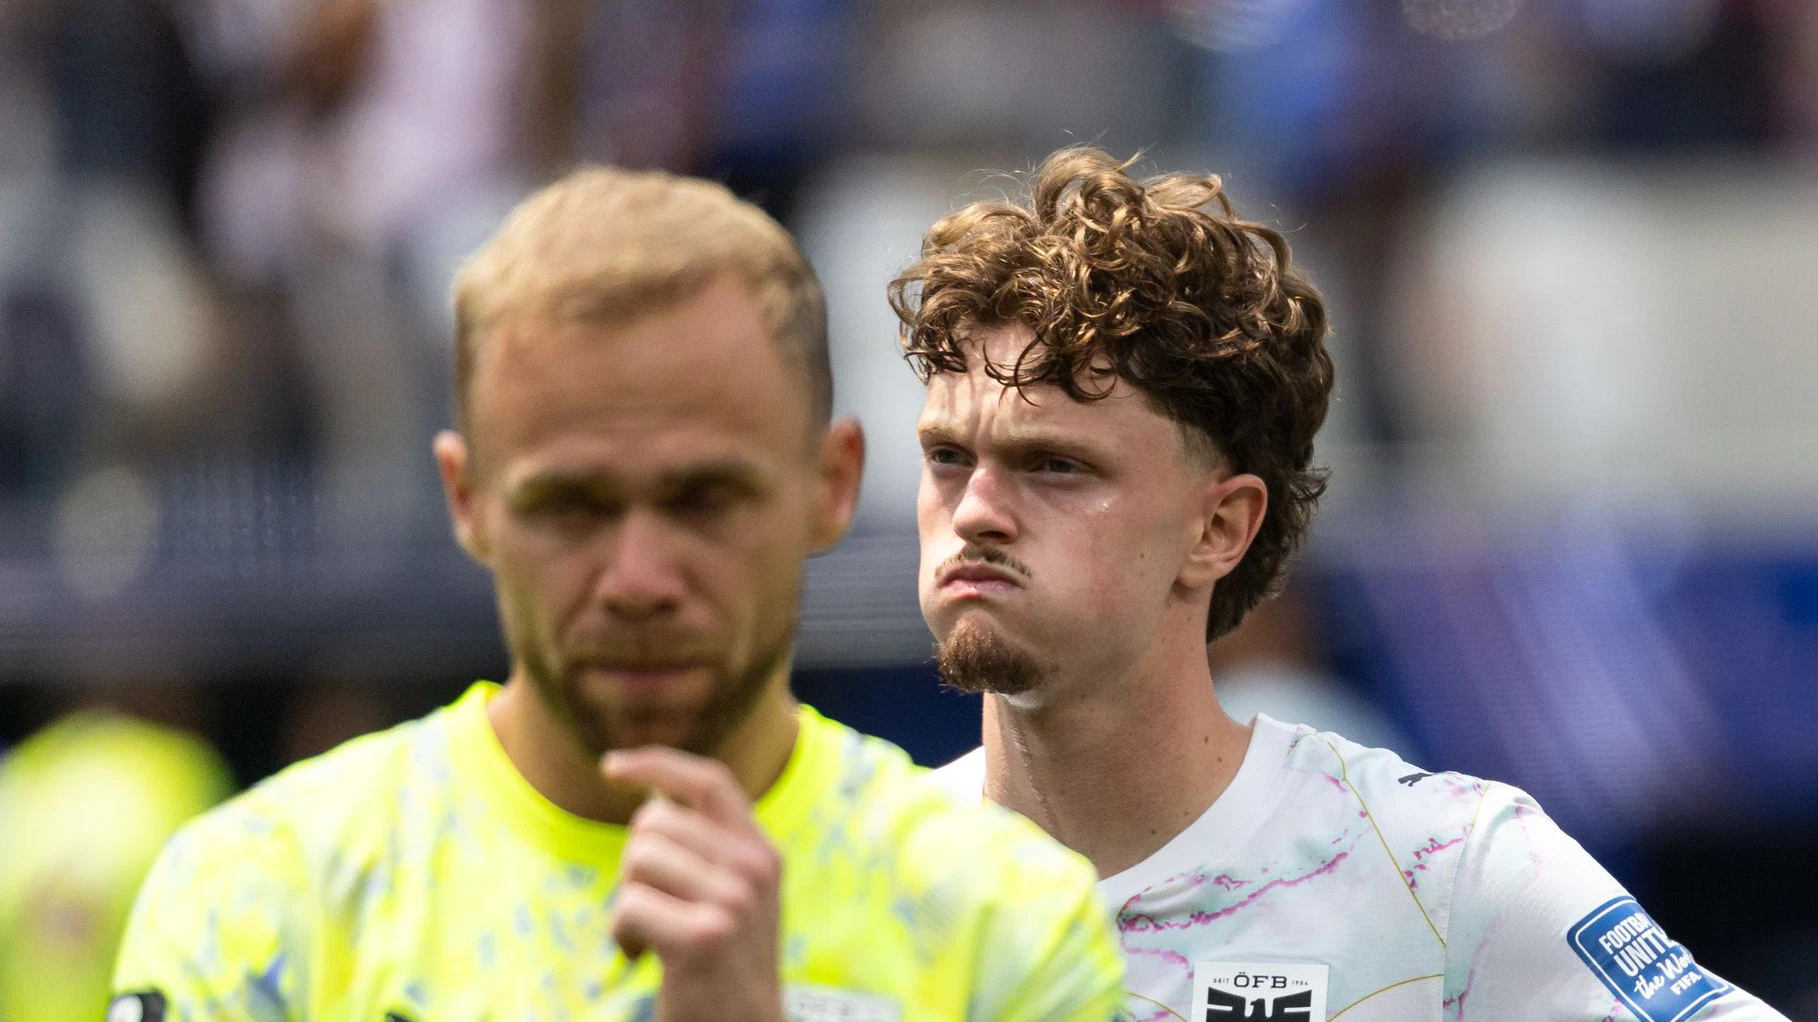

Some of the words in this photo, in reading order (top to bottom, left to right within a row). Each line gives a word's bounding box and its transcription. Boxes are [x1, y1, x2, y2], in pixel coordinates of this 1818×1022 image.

[1598, 912, 1653, 955] FOOTBA
[1613, 926, 1678, 977] UNITE
[1233, 971, 1287, 989] ÖFB
[1633, 974, 1665, 1000] the
[1670, 971, 1702, 996] FIFA
